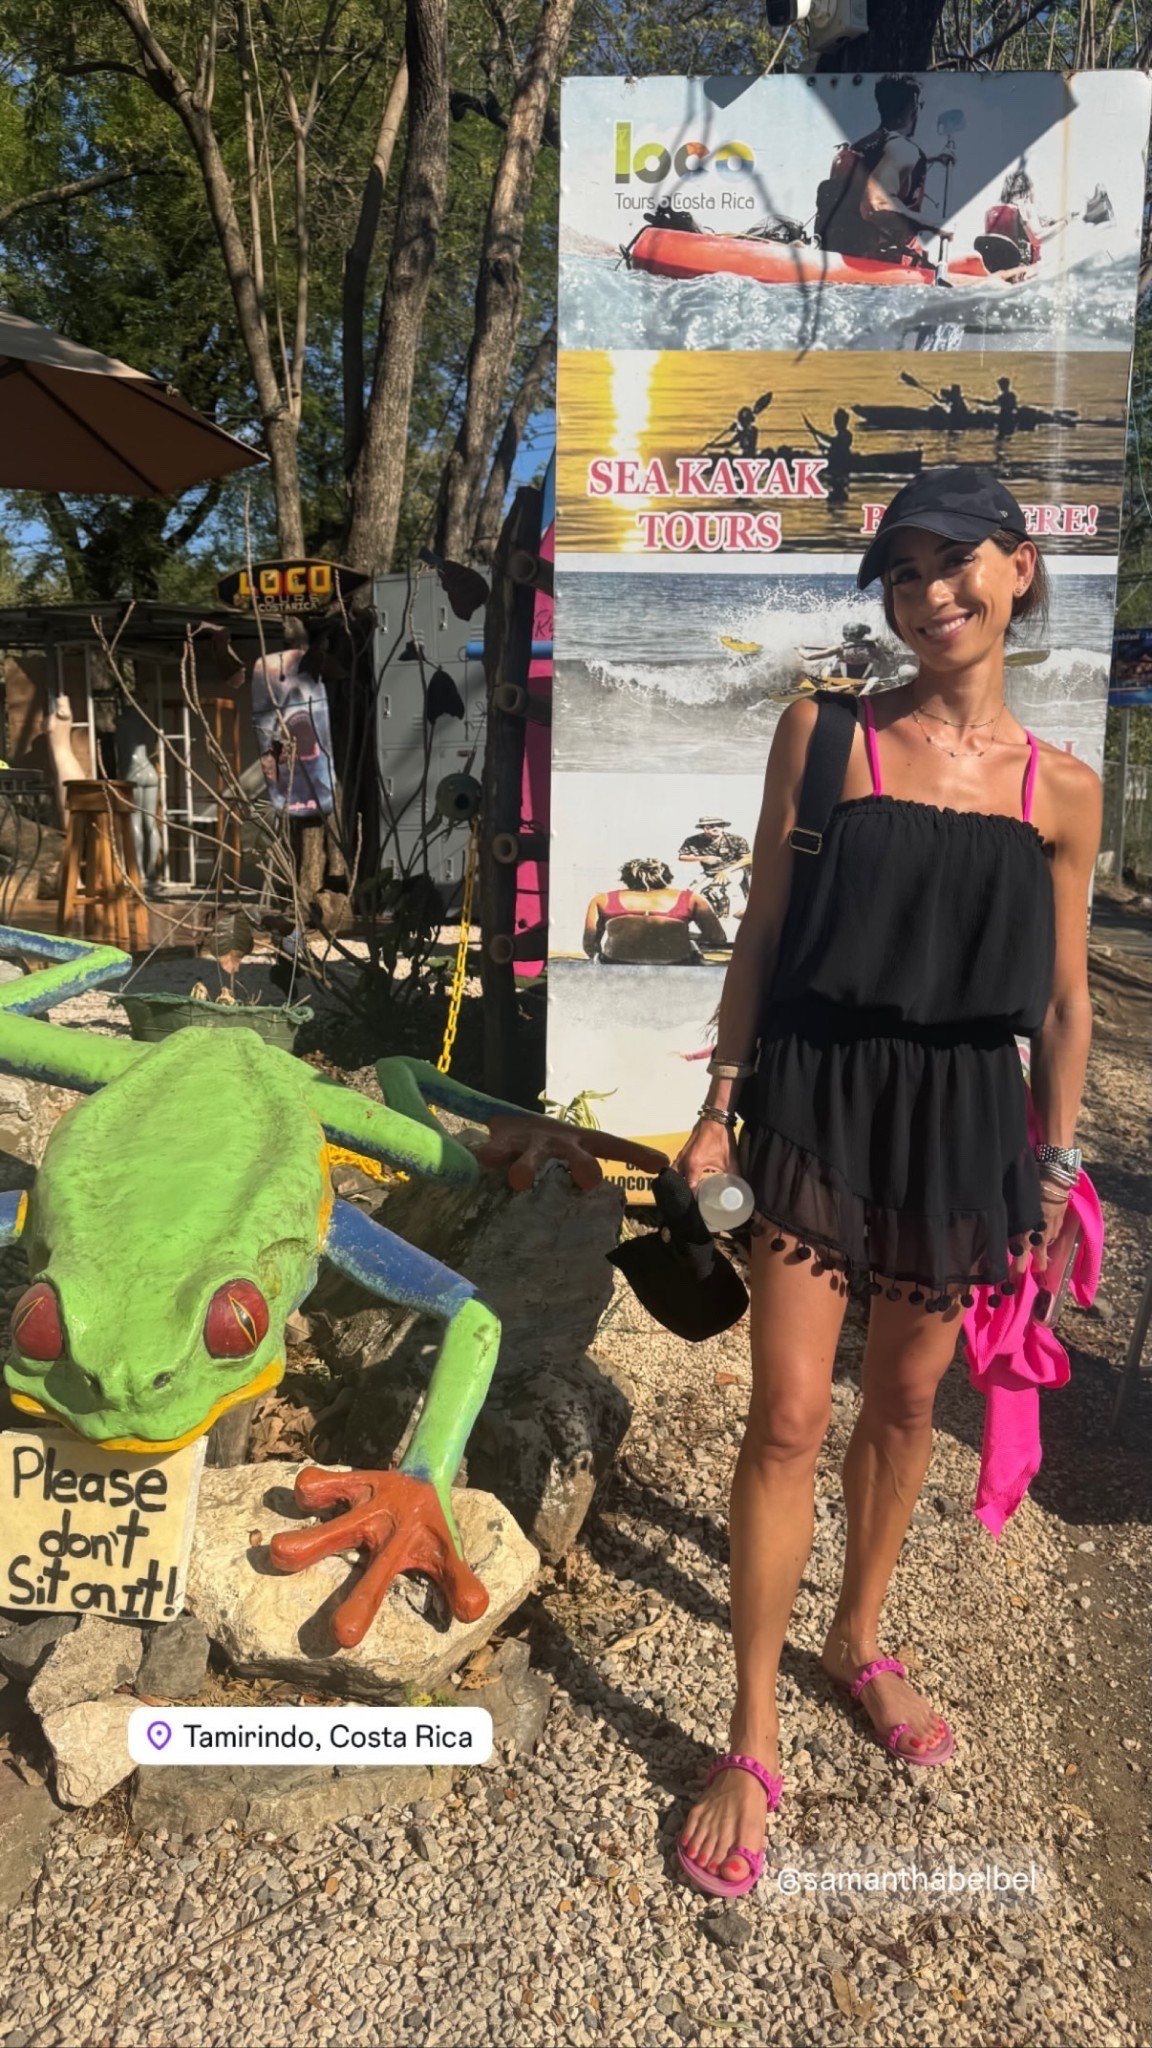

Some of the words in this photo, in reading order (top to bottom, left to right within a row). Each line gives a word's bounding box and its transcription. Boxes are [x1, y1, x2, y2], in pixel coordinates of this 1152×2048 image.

[615, 122, 755, 184] loco
[614, 192, 656, 210] Tours
[673, 192, 716, 210] Costa
[721, 192, 755, 210] Rica
[588, 459, 671, 497] SEA
[677, 459, 828, 498] KAYAK
[637, 512, 782, 550] TOURS
[239, 565, 332, 596] LOCO
[13, 1446, 168, 1513] Please
[39, 1508, 150, 1569] don't
[8, 1554, 70, 1605] Sit
[71, 1582, 117, 1614] on
